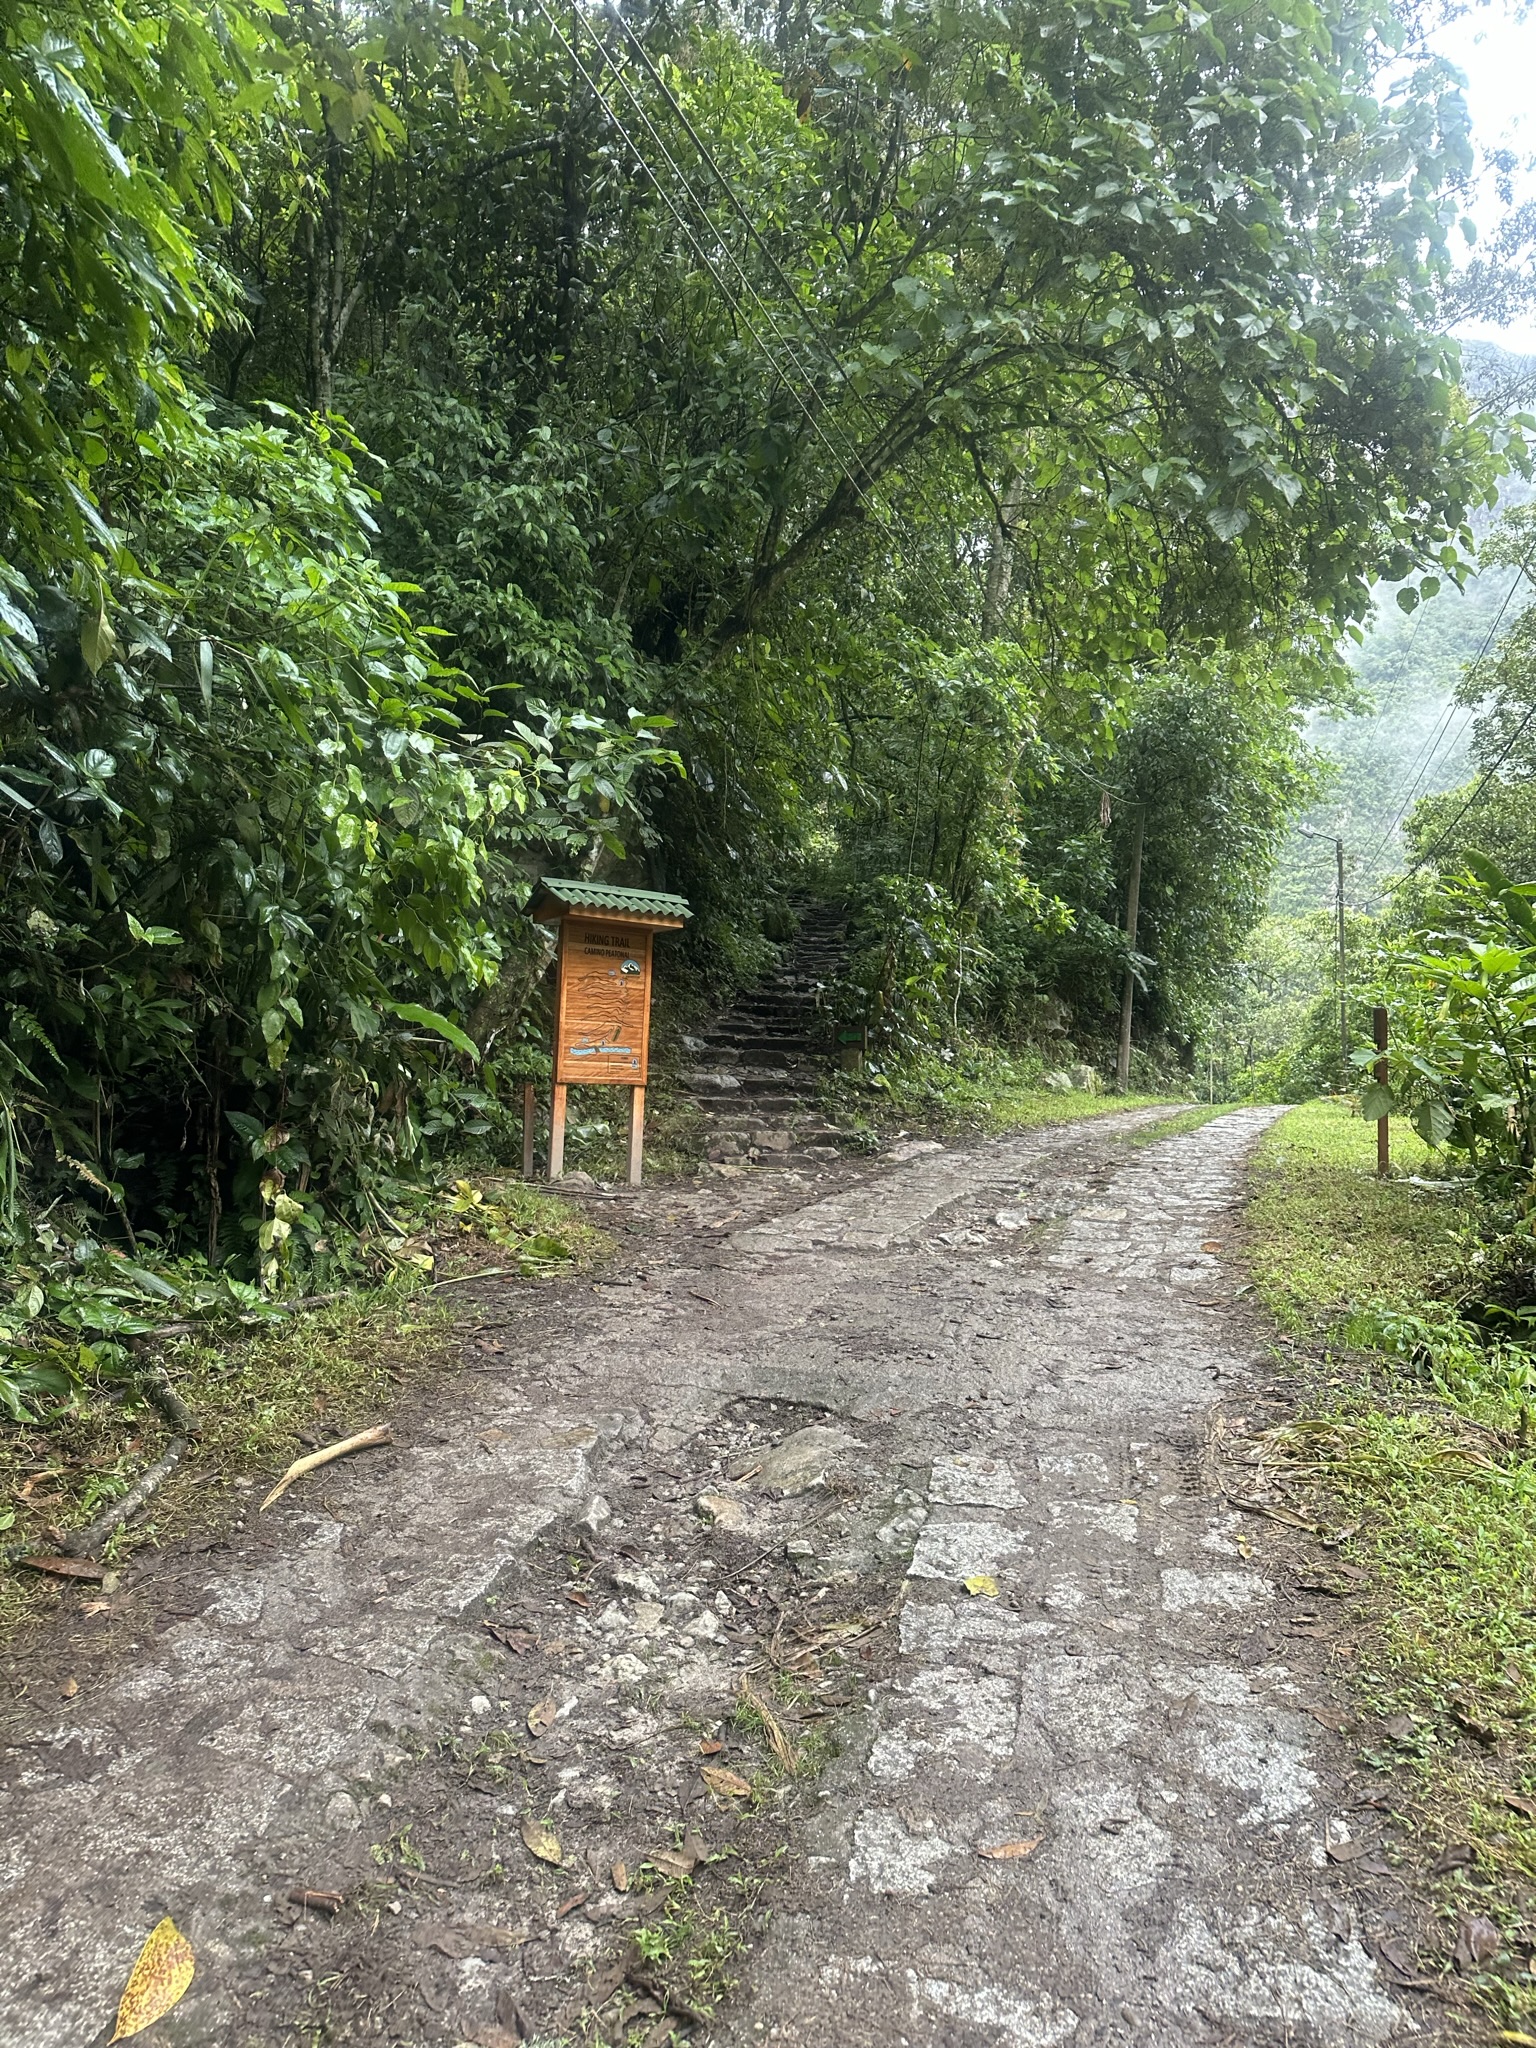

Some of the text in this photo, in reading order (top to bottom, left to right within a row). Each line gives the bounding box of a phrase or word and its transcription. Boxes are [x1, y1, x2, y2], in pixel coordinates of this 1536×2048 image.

[584, 933, 630, 948] HIKING TRAIL
[584, 947, 630, 958] CAMINO PEATONAL
